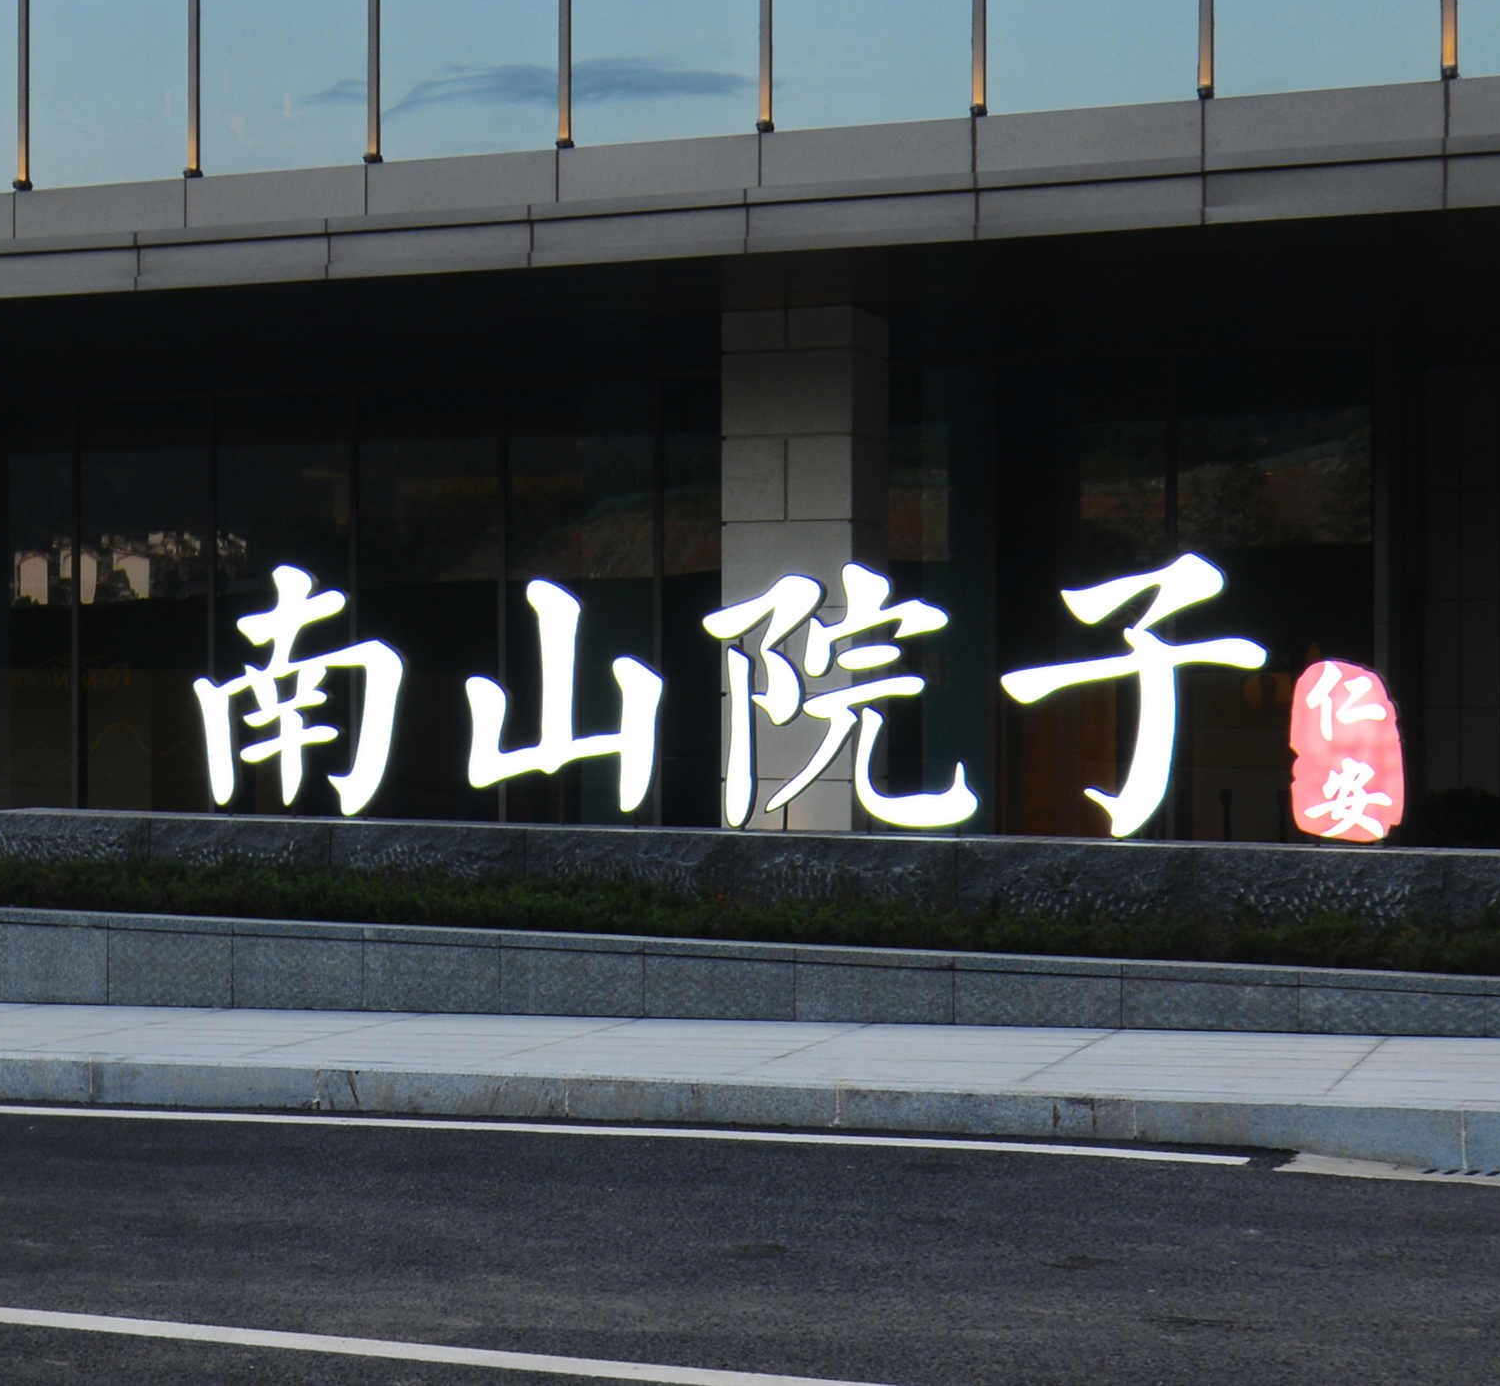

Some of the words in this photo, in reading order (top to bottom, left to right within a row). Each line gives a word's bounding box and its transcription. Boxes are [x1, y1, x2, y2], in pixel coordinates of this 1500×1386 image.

[193, 553, 1267, 837] 南山院子
[1303, 659, 1392, 838] 仁安
